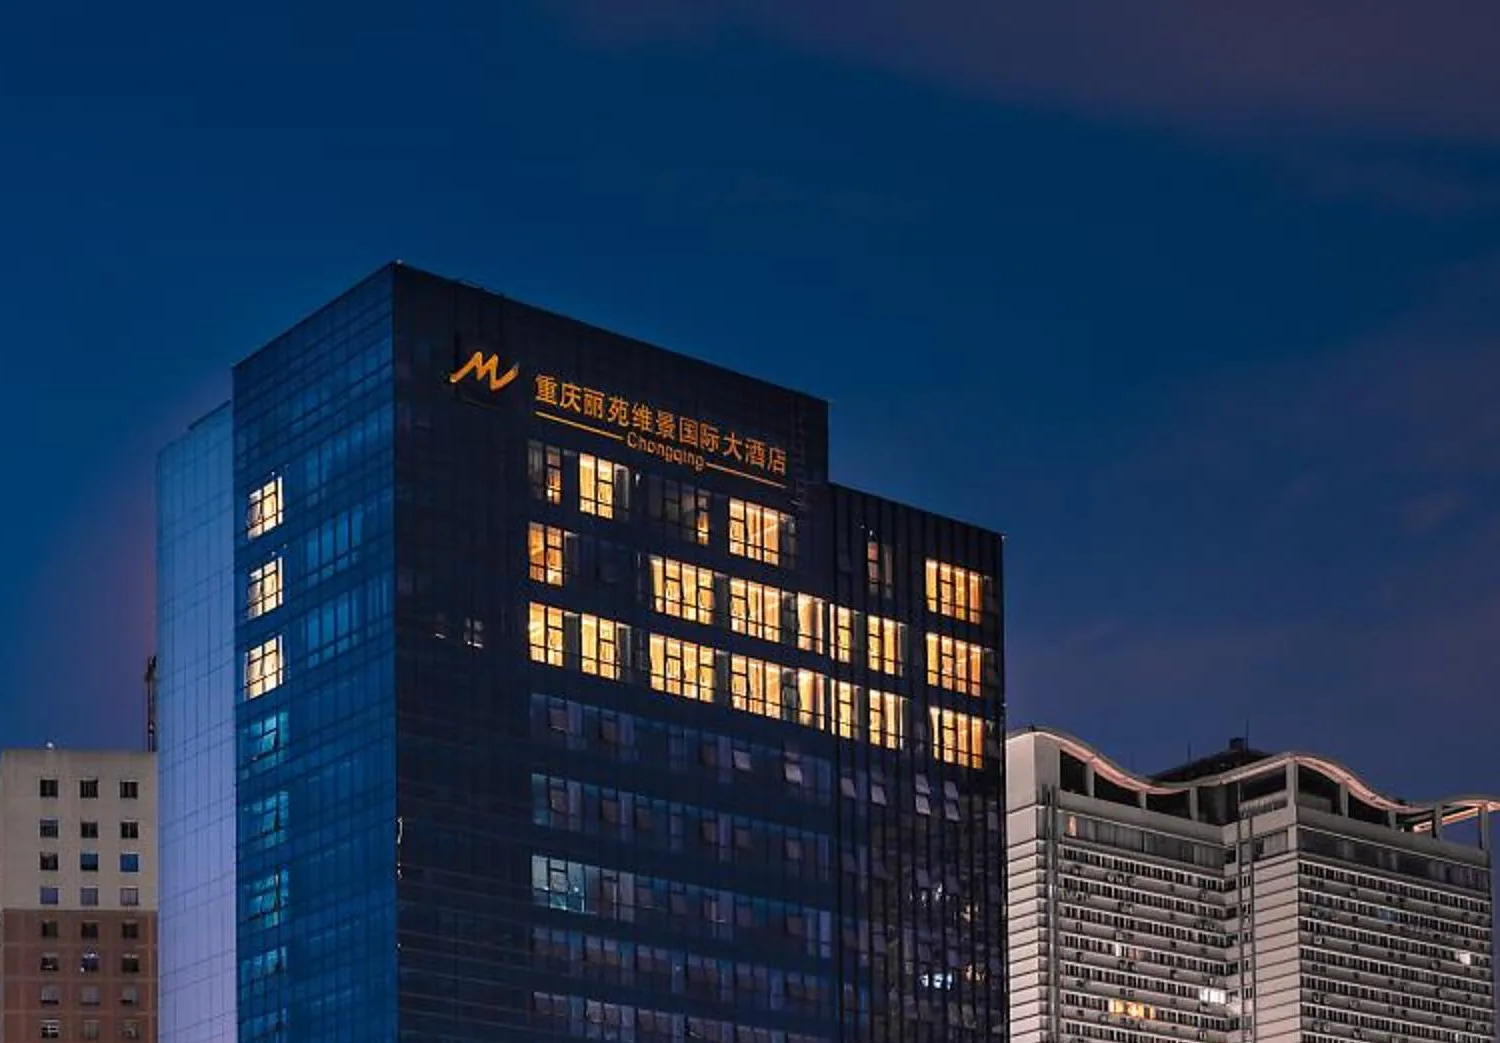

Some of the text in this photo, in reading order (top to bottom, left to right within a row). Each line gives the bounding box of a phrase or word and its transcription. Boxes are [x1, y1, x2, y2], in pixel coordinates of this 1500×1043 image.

[535, 374, 787, 477] 重庆丽苑维景国际大酒店
[627, 431, 705, 473] Chongqing
